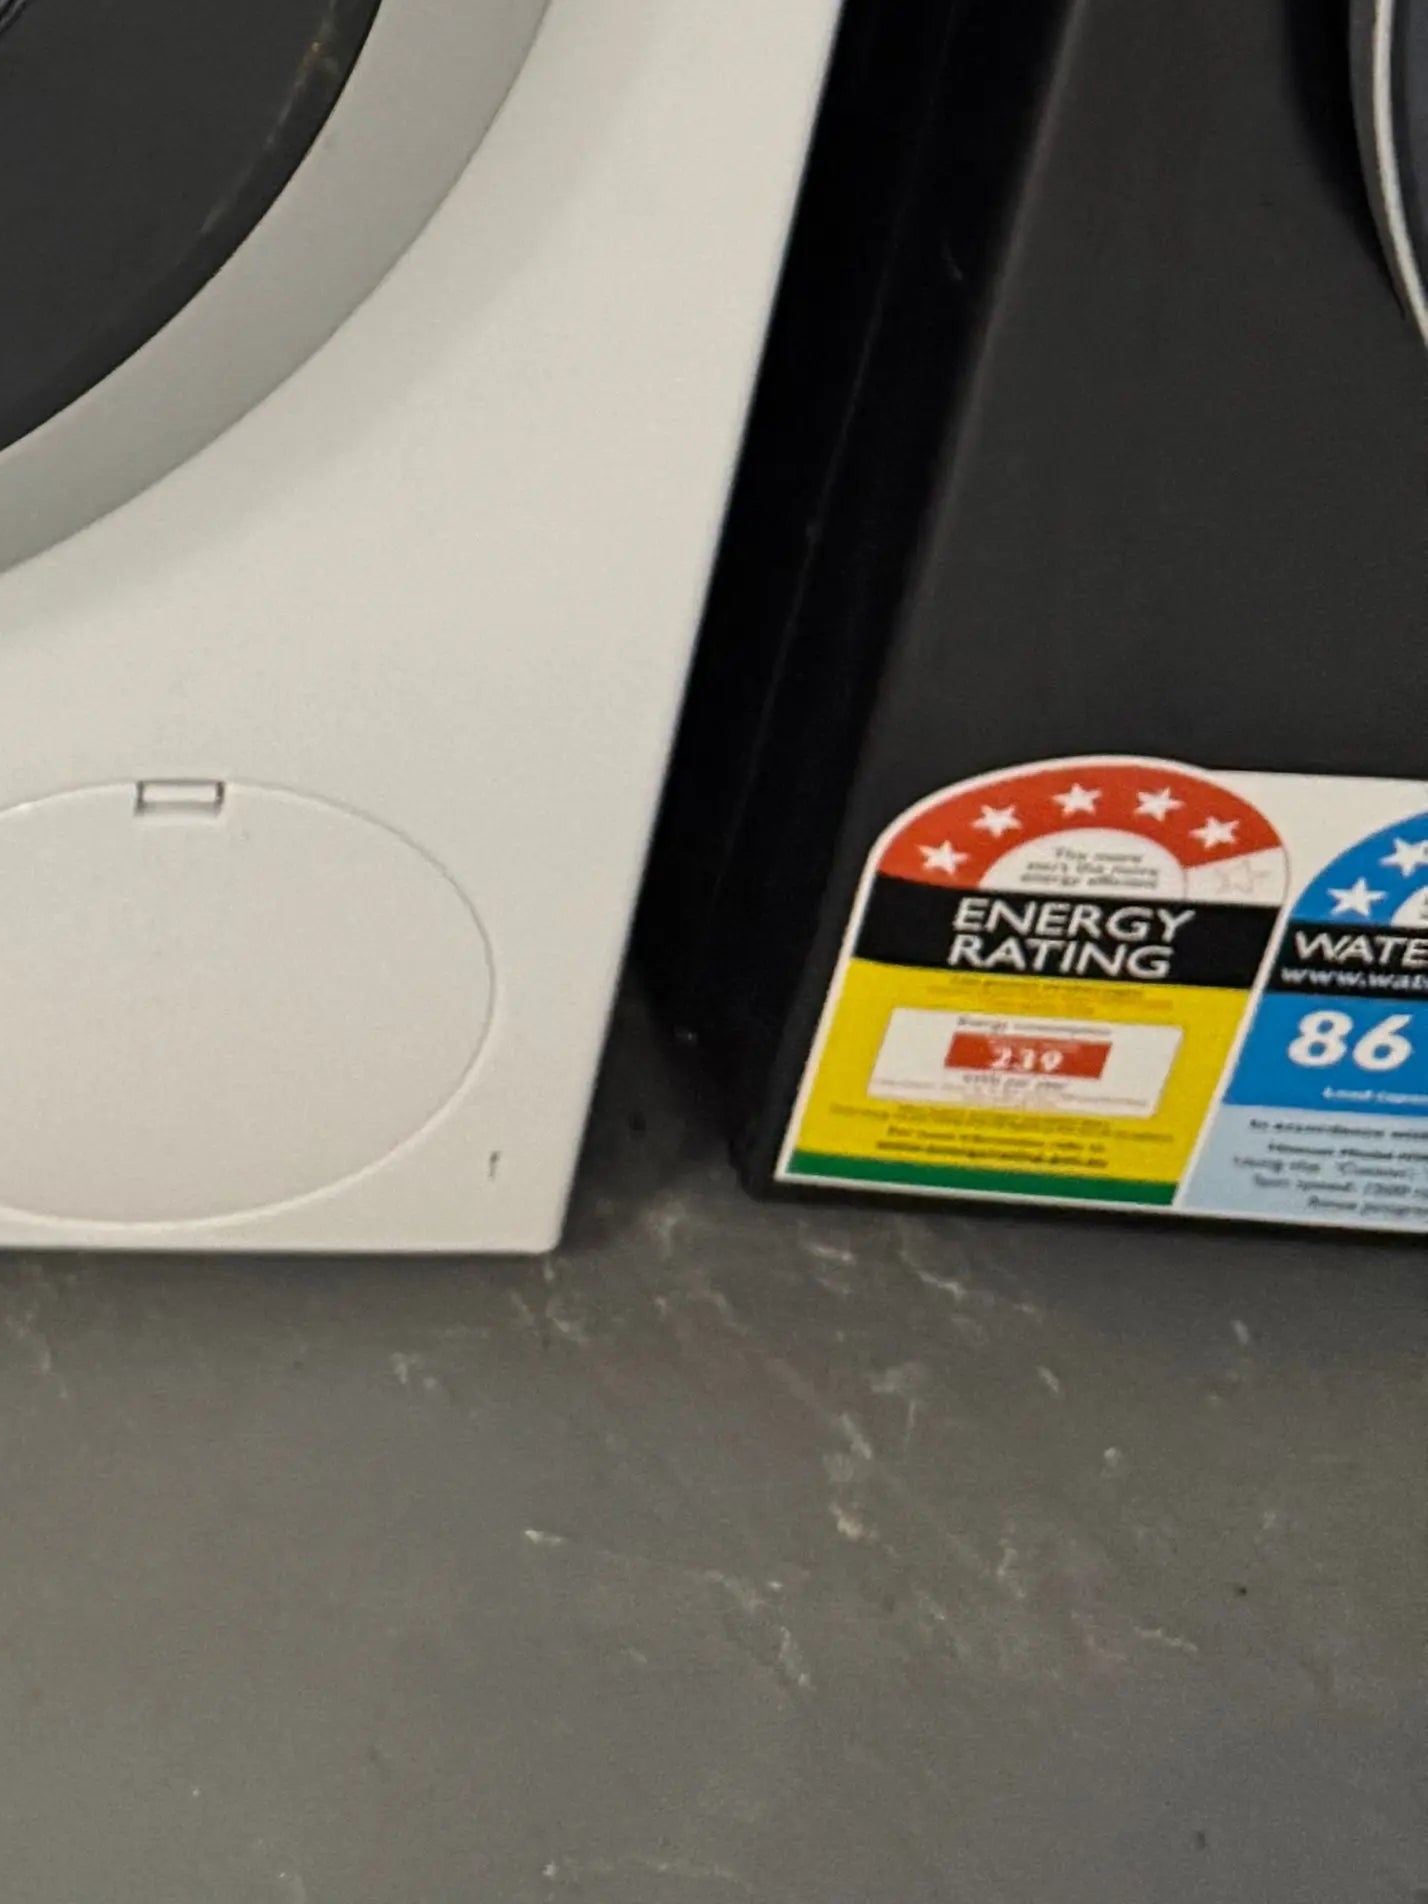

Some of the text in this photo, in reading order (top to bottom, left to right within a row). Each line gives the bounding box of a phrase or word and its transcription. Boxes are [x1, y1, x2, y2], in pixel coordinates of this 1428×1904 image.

[952, 896, 1196, 943] ENERGY
[947, 937, 1175, 979] RATING
[1288, 1009, 1413, 1072] 86
